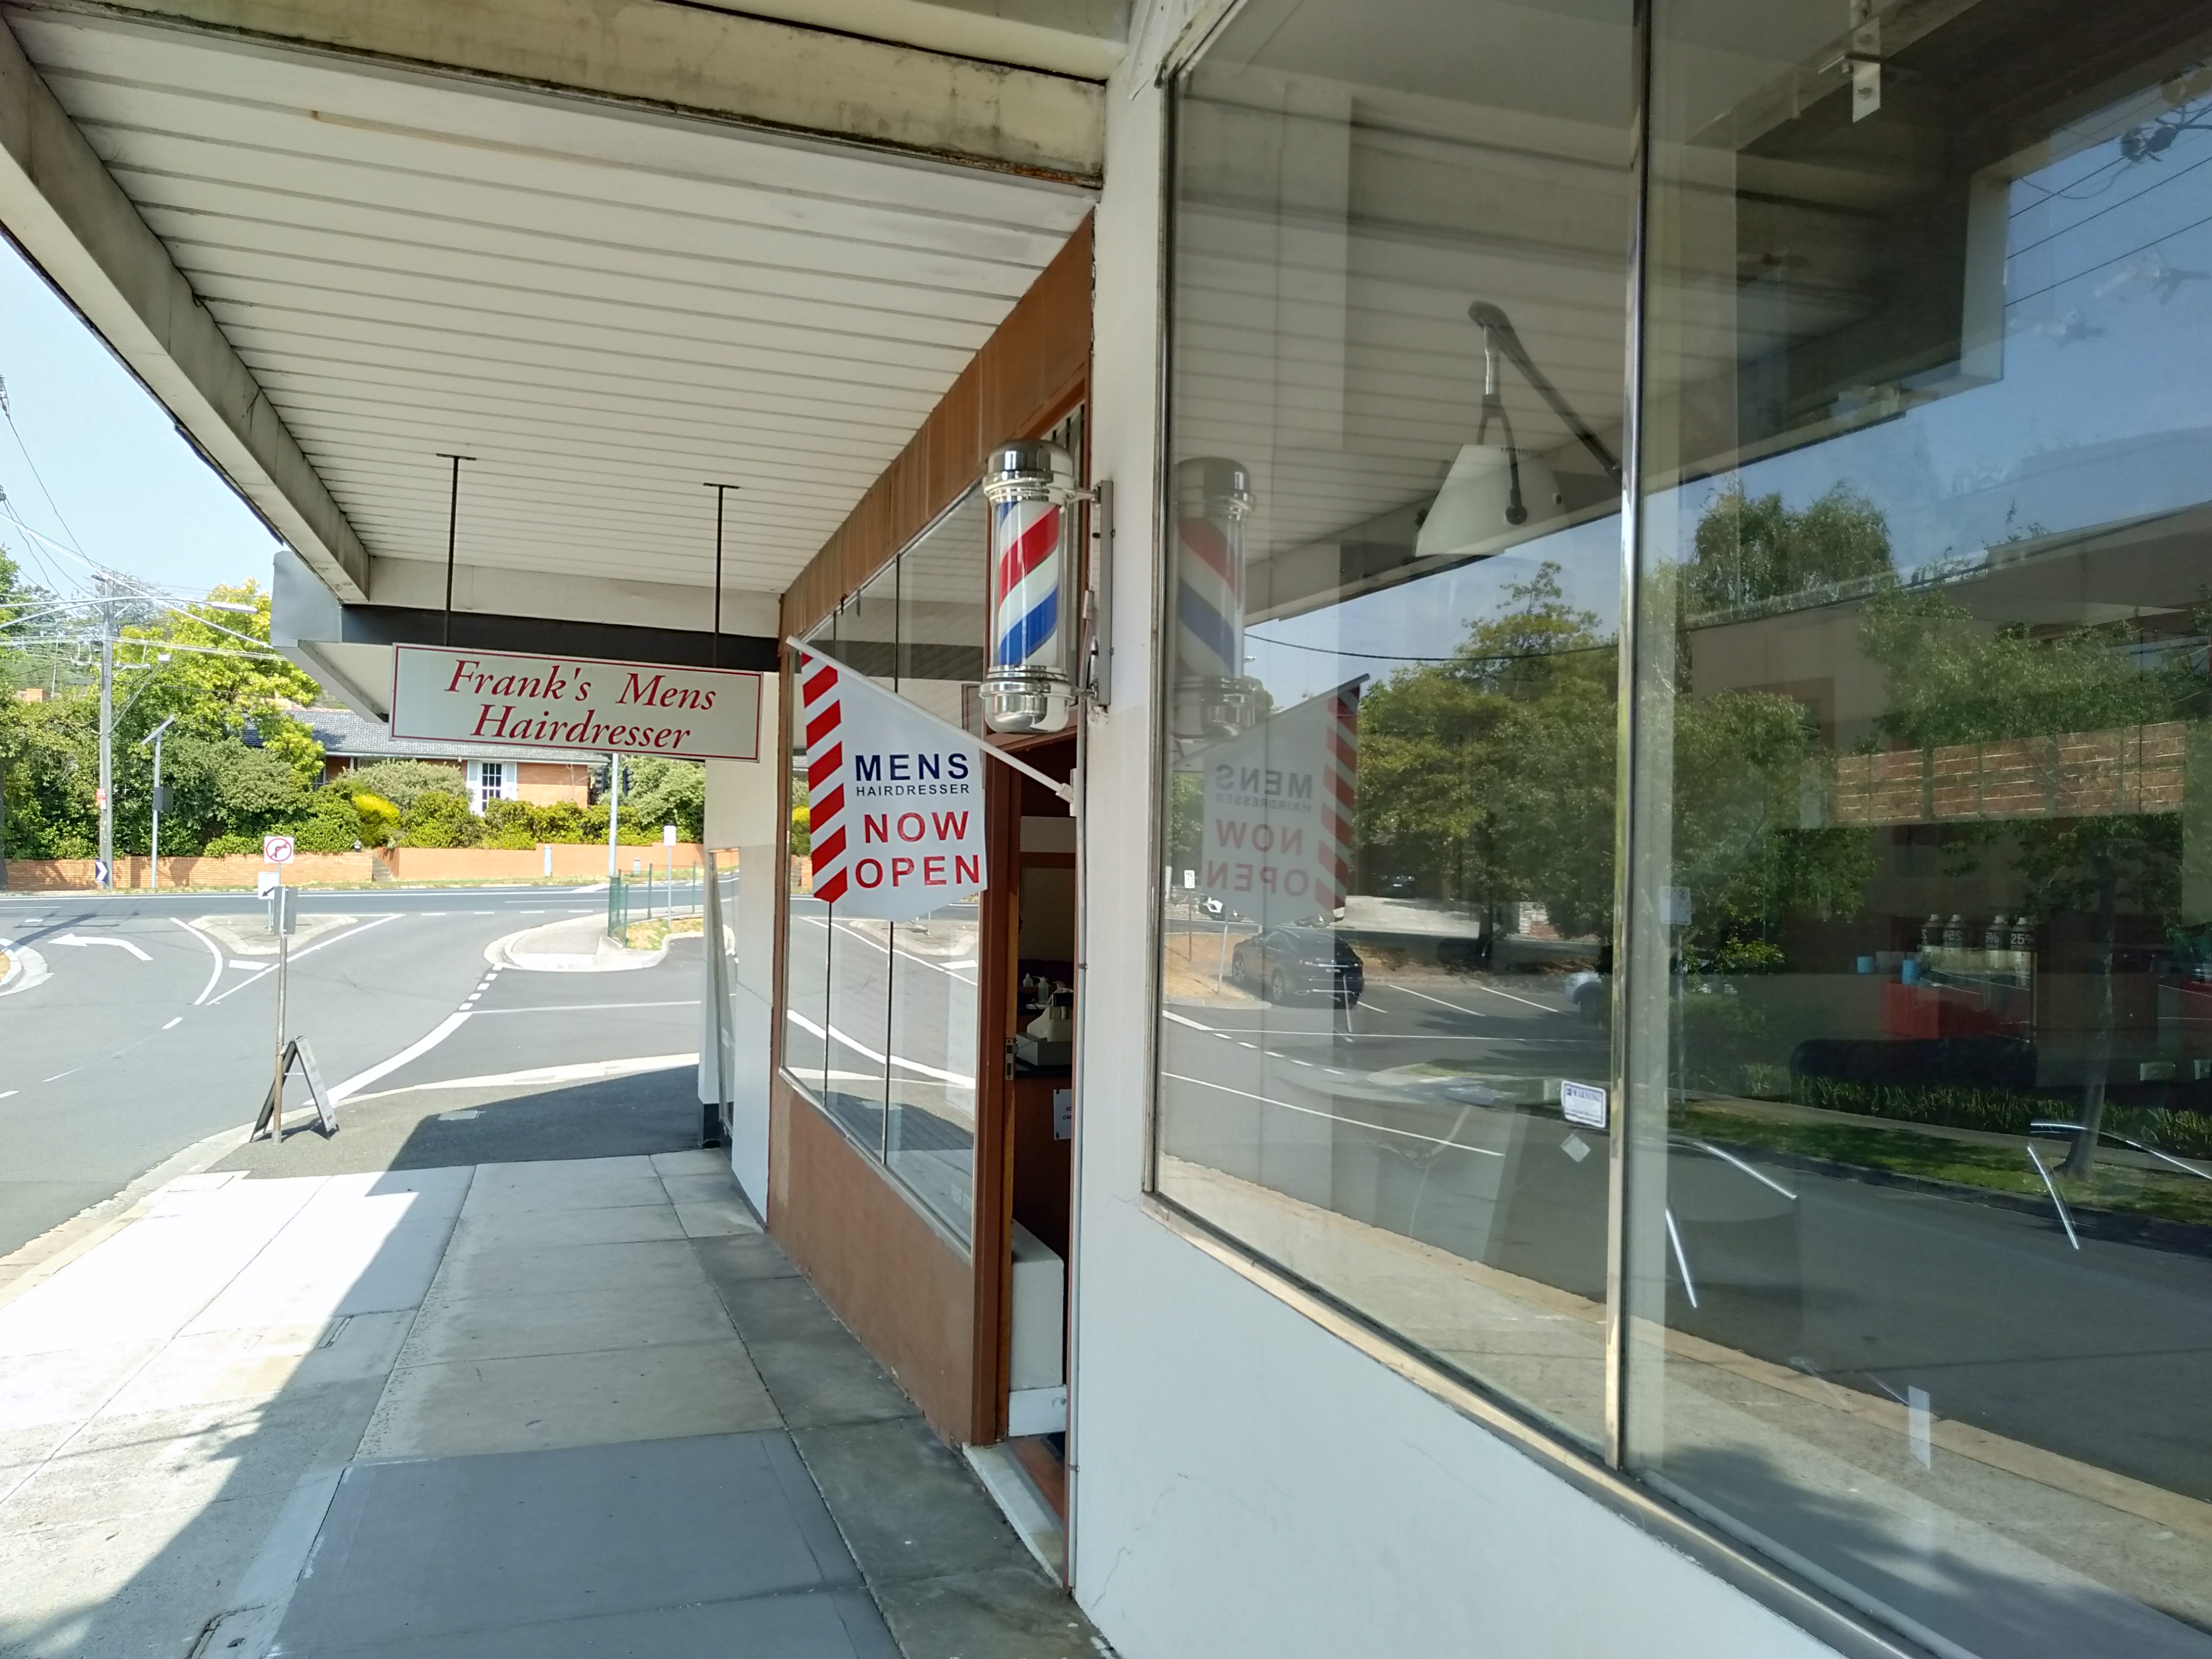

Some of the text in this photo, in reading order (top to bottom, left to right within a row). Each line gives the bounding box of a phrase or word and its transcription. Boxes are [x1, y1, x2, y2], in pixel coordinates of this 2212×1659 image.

[445, 659, 716, 710] Frank's Mens
[470, 703, 691, 749] Hairdresser
[855, 753, 969, 782] MENS
[856, 784, 970, 797] HAIRDRESSER
[864, 811, 969, 843] NOW
[855, 854, 979, 889] OPEN
